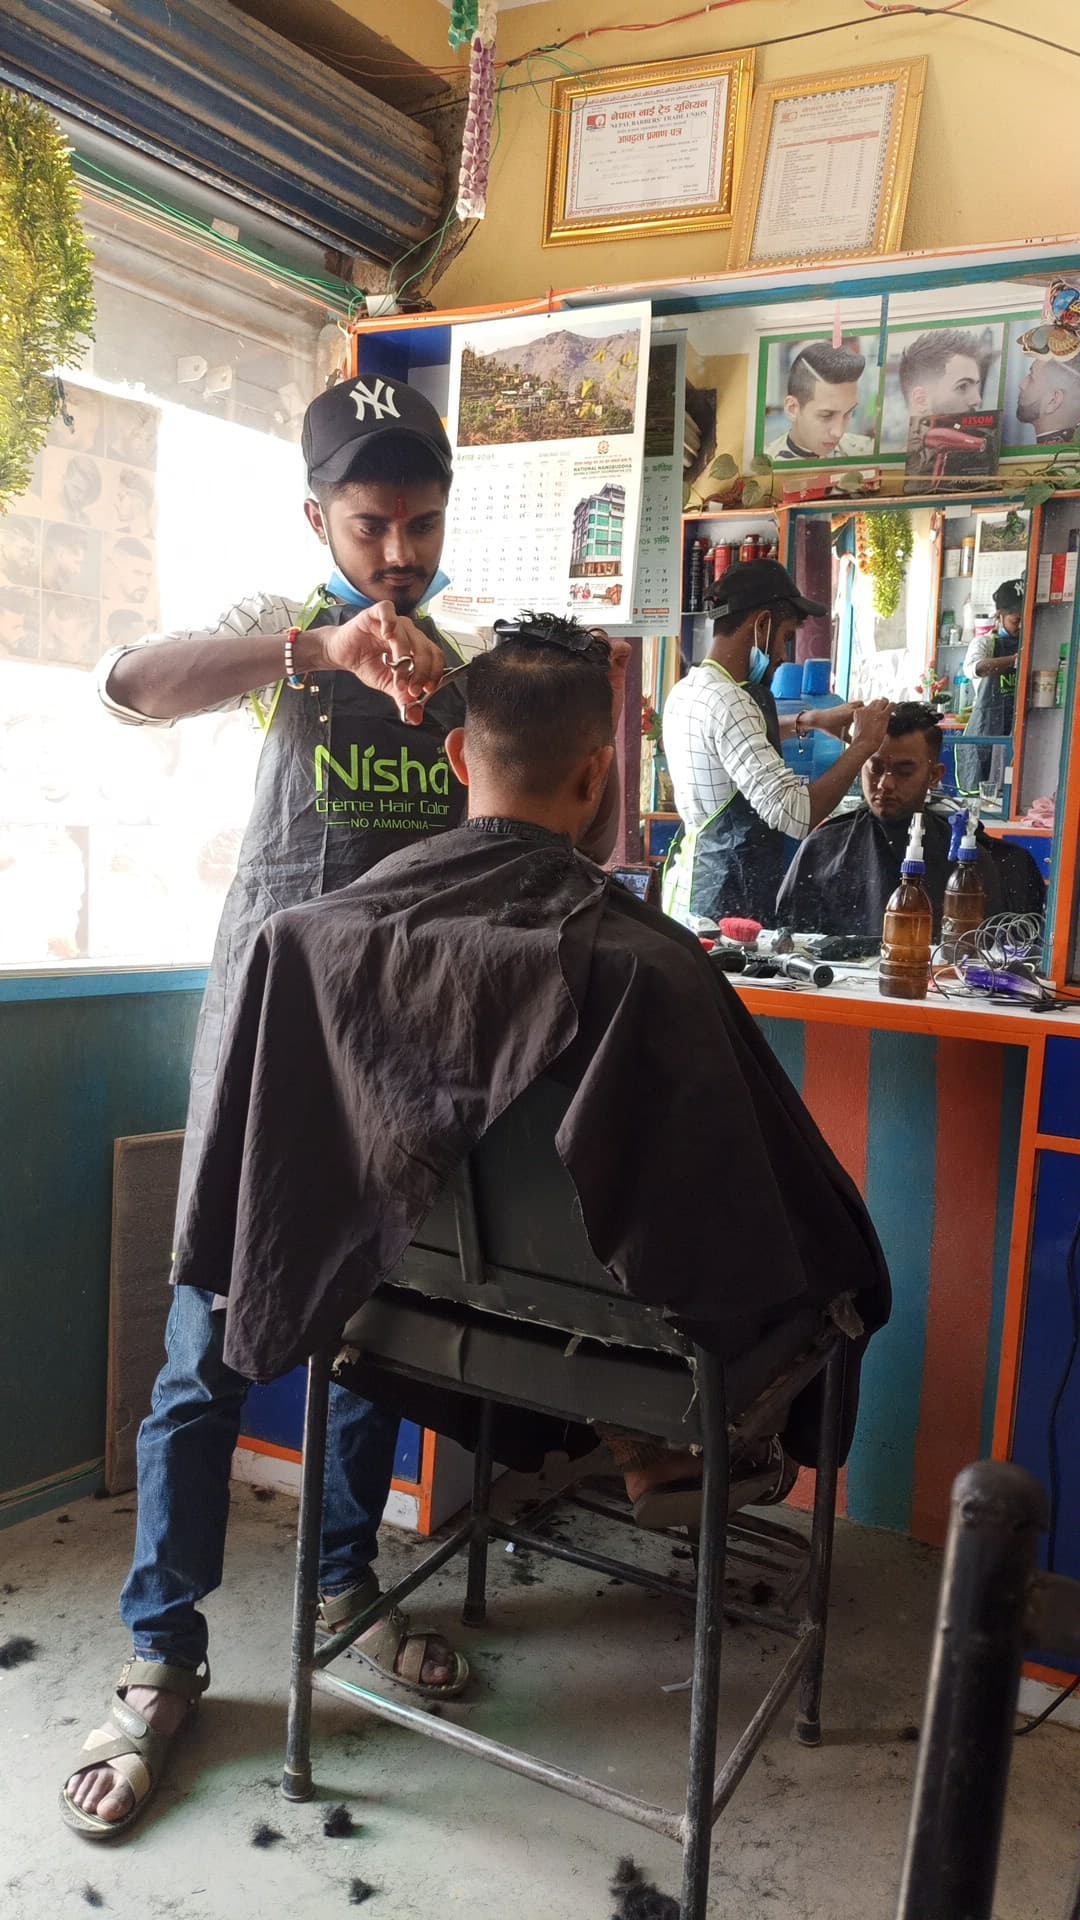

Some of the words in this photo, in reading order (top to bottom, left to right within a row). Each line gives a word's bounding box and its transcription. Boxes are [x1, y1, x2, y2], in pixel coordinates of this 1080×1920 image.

[349, 378, 401, 421] NY
[315, 744, 449, 795] Nisha
[380, 799, 414, 813] Hair
[420, 799, 449, 815] Color
[350, 818, 369, 828] NO
[373, 818, 429, 830] AMMONIA
